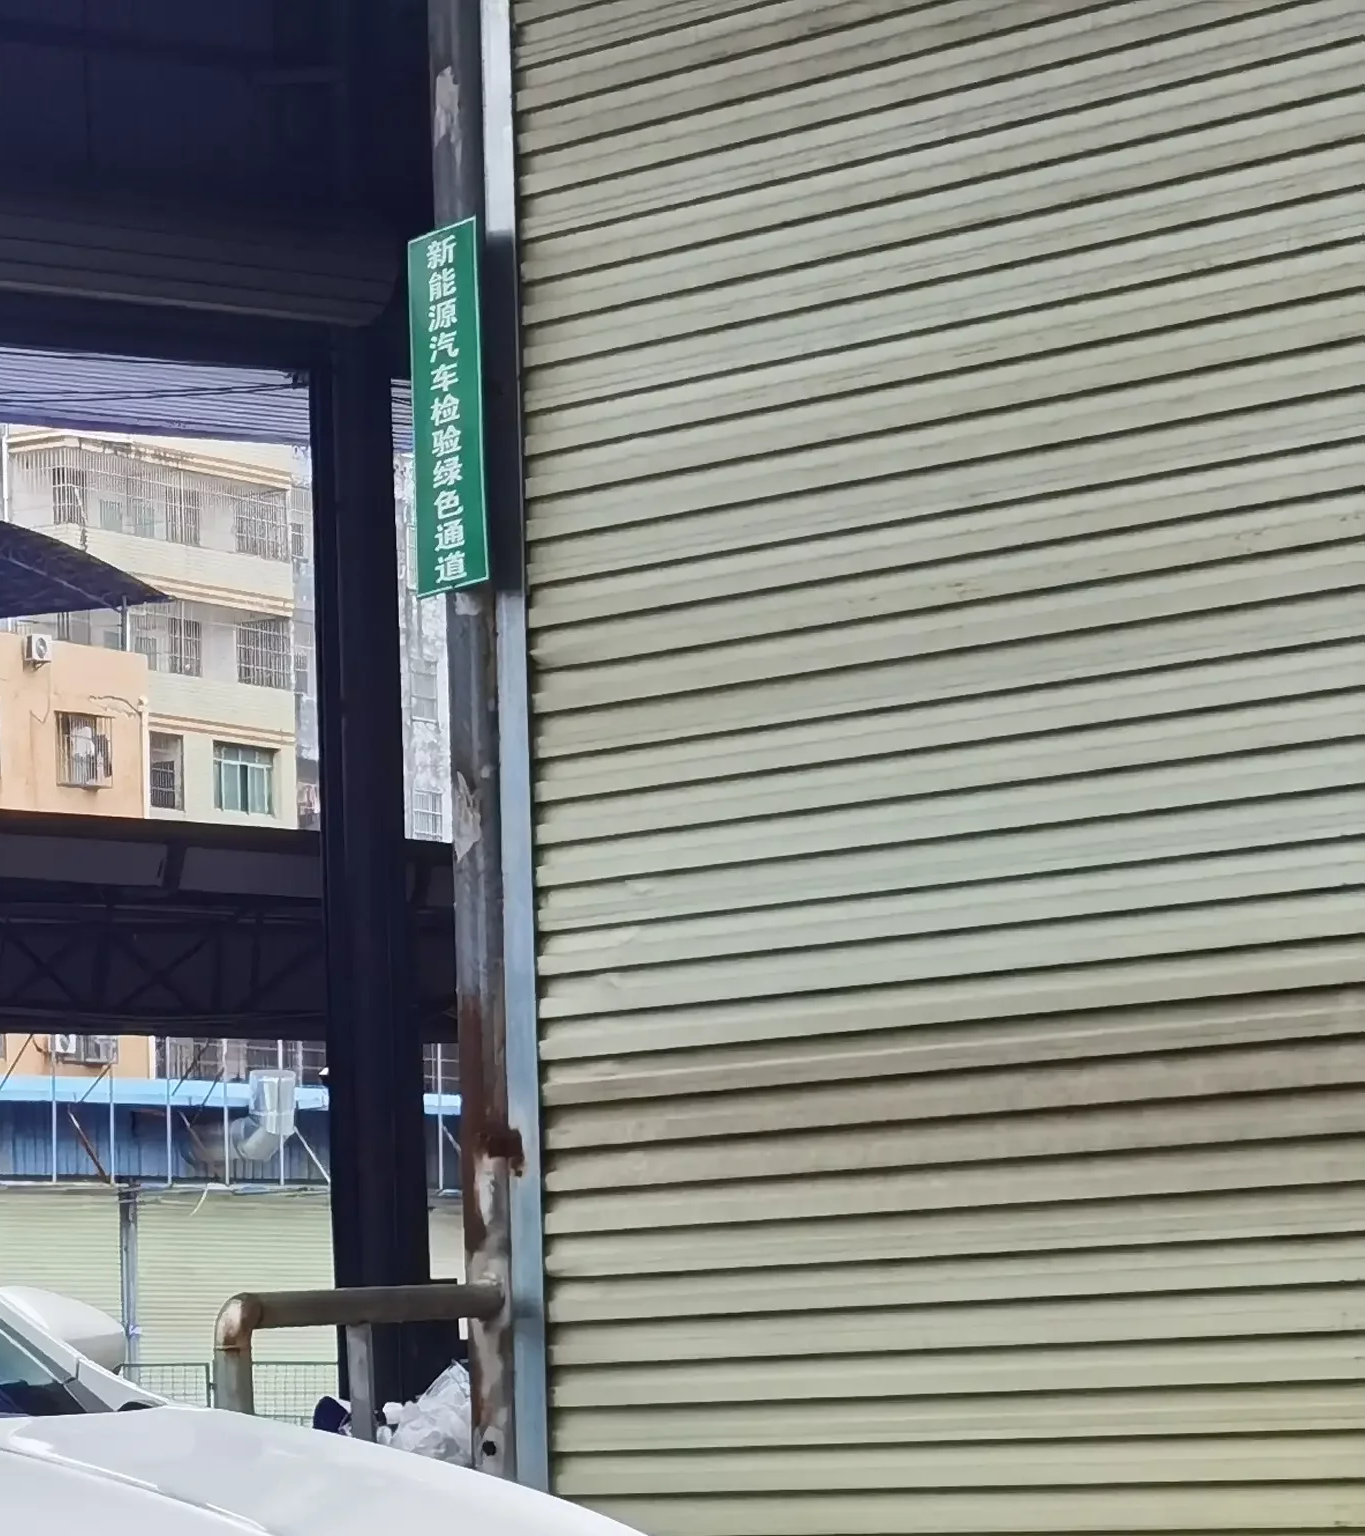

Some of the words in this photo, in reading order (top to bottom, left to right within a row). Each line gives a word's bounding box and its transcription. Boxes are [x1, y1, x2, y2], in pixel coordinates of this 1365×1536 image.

[426, 234, 468, 585] 新能源汽车检验绿色通道
